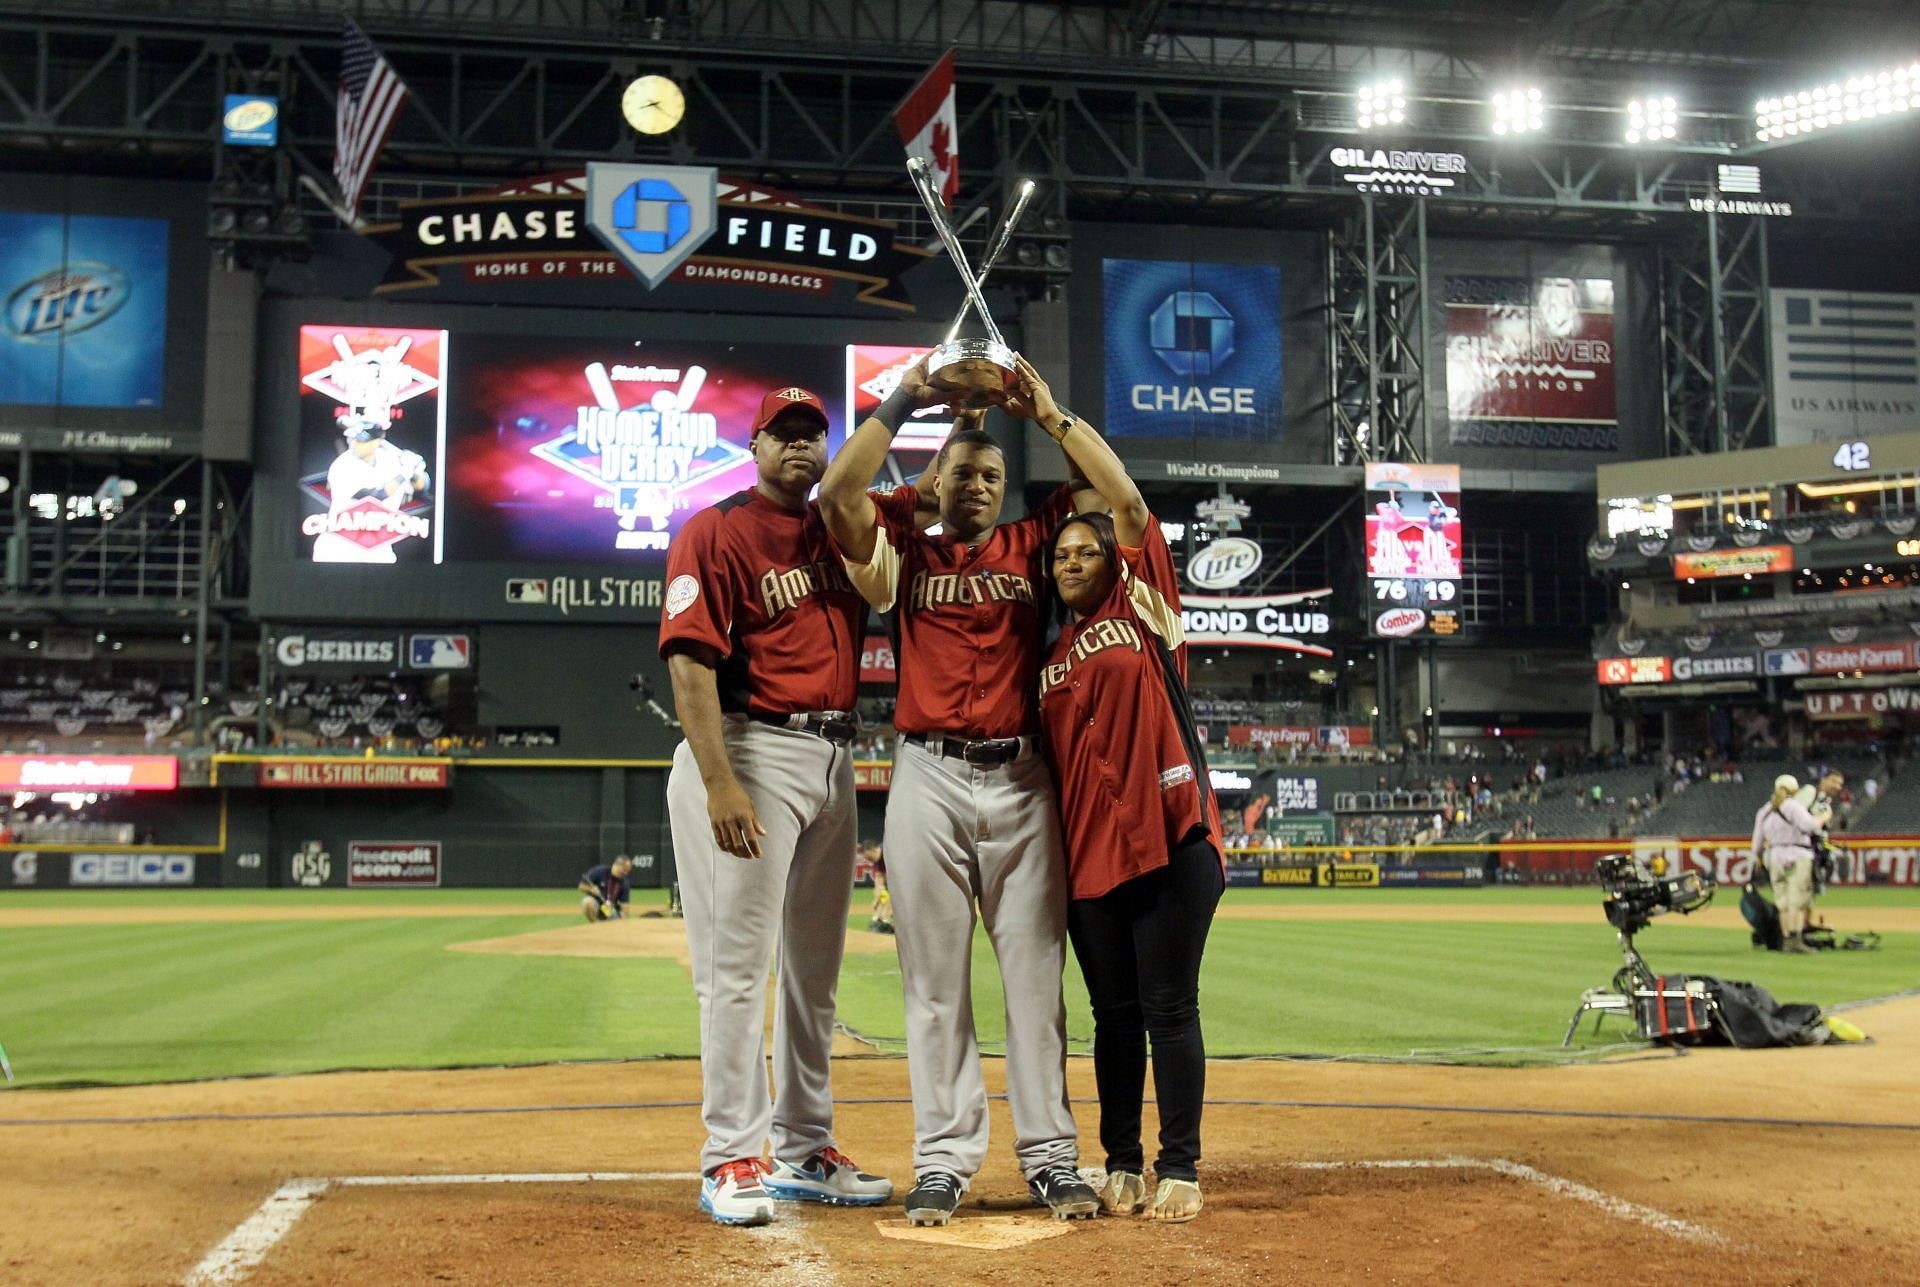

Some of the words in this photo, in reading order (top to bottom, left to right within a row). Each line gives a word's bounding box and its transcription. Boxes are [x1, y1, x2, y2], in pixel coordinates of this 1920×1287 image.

[1357, 183, 1442, 196] CASINOS
[1690, 199, 1715, 213] US
[1717, 200, 1792, 216] AIRWAYS
[418, 211, 576, 245] CHASE
[728, 218, 877, 261] FIELD
[475, 262, 529, 276] HOME
[543, 262, 566, 274] OF
[580, 262, 616, 274] THE
[685, 265, 823, 289] DIAMONDBACKS
[1490, 379, 1583, 392] ASINOS
[1131, 384, 1256, 414] CHASE
[1791, 398, 1819, 411] US
[1825, 398, 1915, 415] AIRWAYS
[577, 406, 660, 453] HOME
[661, 408, 717, 456] RUN
[600, 445, 694, 481] DERBY
[1833, 442, 1870, 471] 42
[1166, 463, 1206, 477] World
[1207, 463, 1280, 481] Champions
[302, 510, 430, 538] CHAMPION
[616, 531, 670, 549] ESPN
[1205, 554, 1248, 581] Lite
[552, 576, 595, 615] ALL
[601, 577, 662, 606] STAR
[1374, 580, 1407, 600] 76
[1424, 580, 1455, 601] 19
[1256, 608, 1330, 634] CLUB
[1381, 612, 1421, 630] Combos
[306, 641, 394, 662] SERIES
[1039, 619, 1141, 699] erican
[1815, 650, 1858, 669] State
[1859, 648, 1904, 667] Farm
[1693, 656, 1753, 675] SERIES
[1251, 728, 1279, 743] State
[1280, 729, 1311, 743] Farm
[292, 764, 321, 783] ALL
[324, 765, 362, 783] STAR
[365, 765, 407, 783] GAME
[409, 767, 440, 782] FOX
[1277, 778, 1317, 791] MLB
[1278, 790, 1303, 800] FAN
[1278, 799, 1317, 809] CAVE
[352, 848, 432, 864] freecredit
[1689, 846, 1753, 886] Sta
[71, 855, 194, 884] GEICO
[292, 852, 330, 882] ASG
[352, 863, 435, 877] score.com
